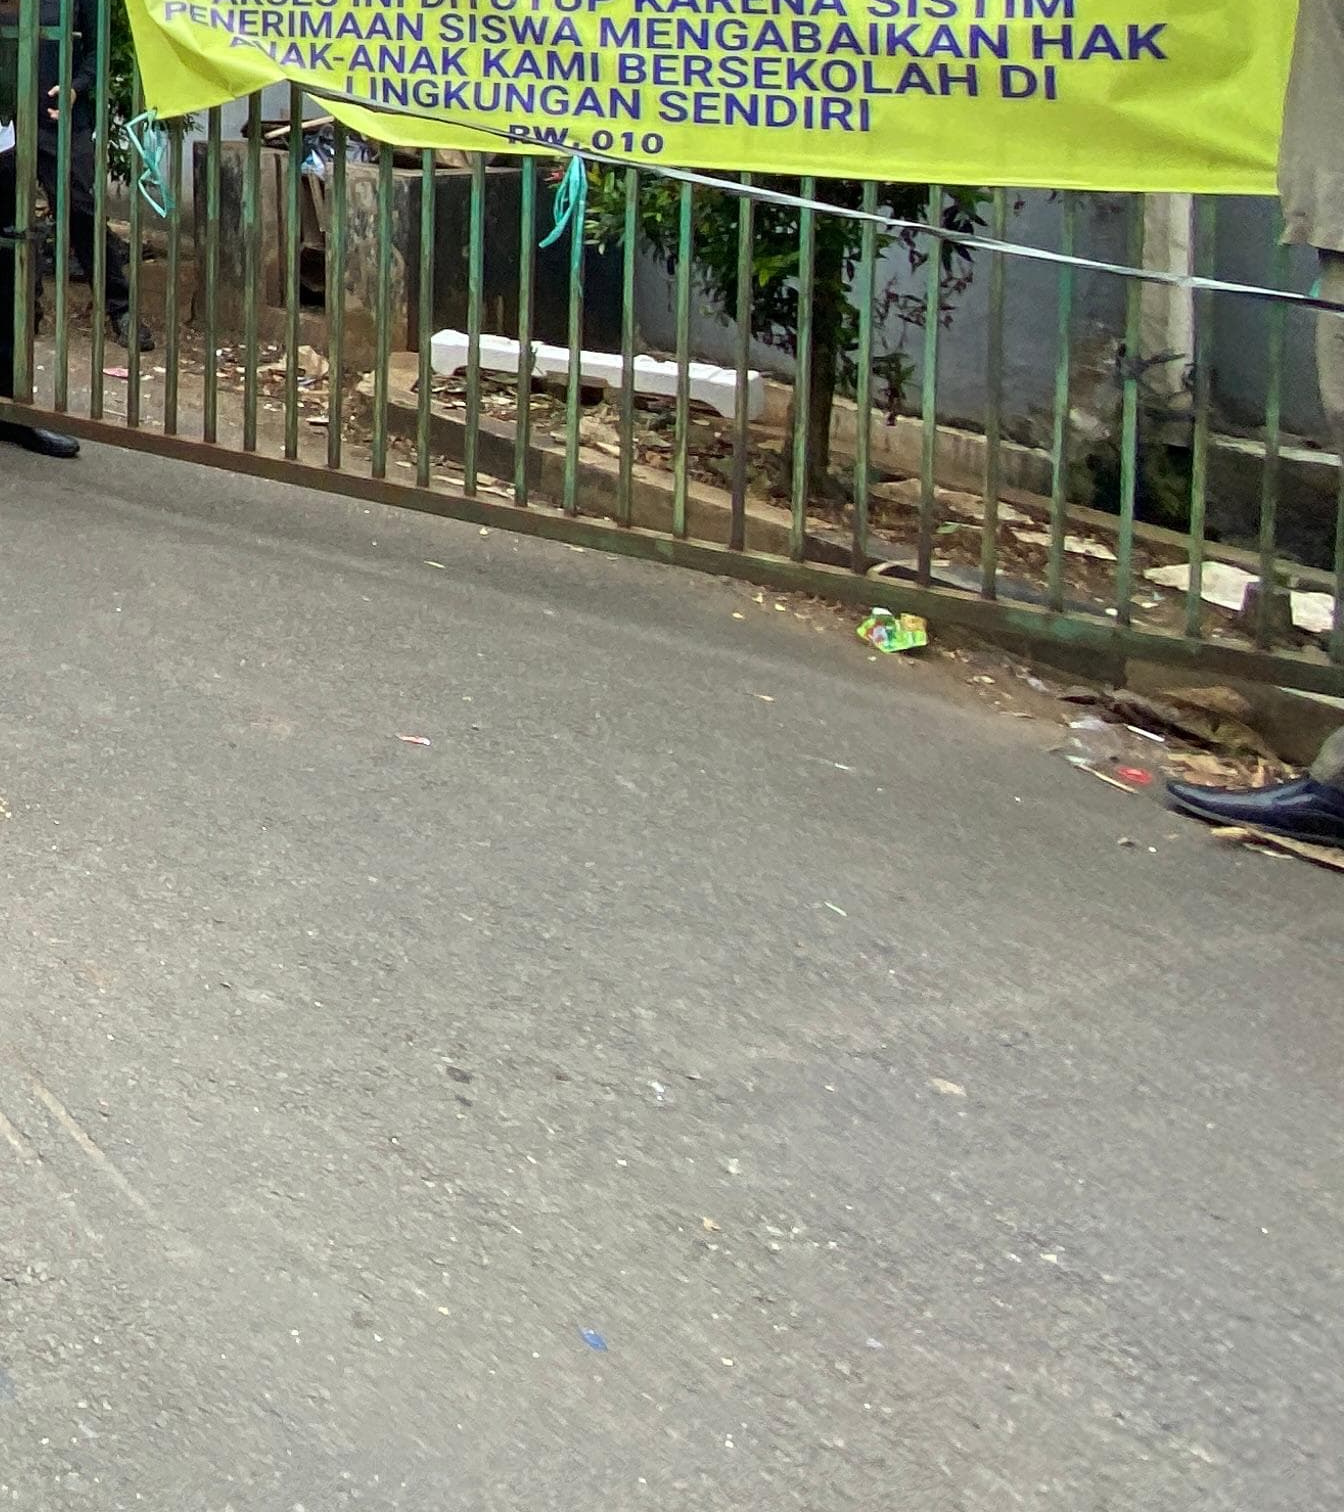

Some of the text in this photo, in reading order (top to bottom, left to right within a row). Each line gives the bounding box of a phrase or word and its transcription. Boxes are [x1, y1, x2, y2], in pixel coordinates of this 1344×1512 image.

[164, 1, 1168, 61] PENERIMAAN SISWA MENGABAIKAN HAK
[483, 50, 599, 82] KAMI
[618, 54, 978, 97] BERSEKOLAH
[1000, 64, 1057, 101] DI
[658, 90, 871, 132] SENDIRI
